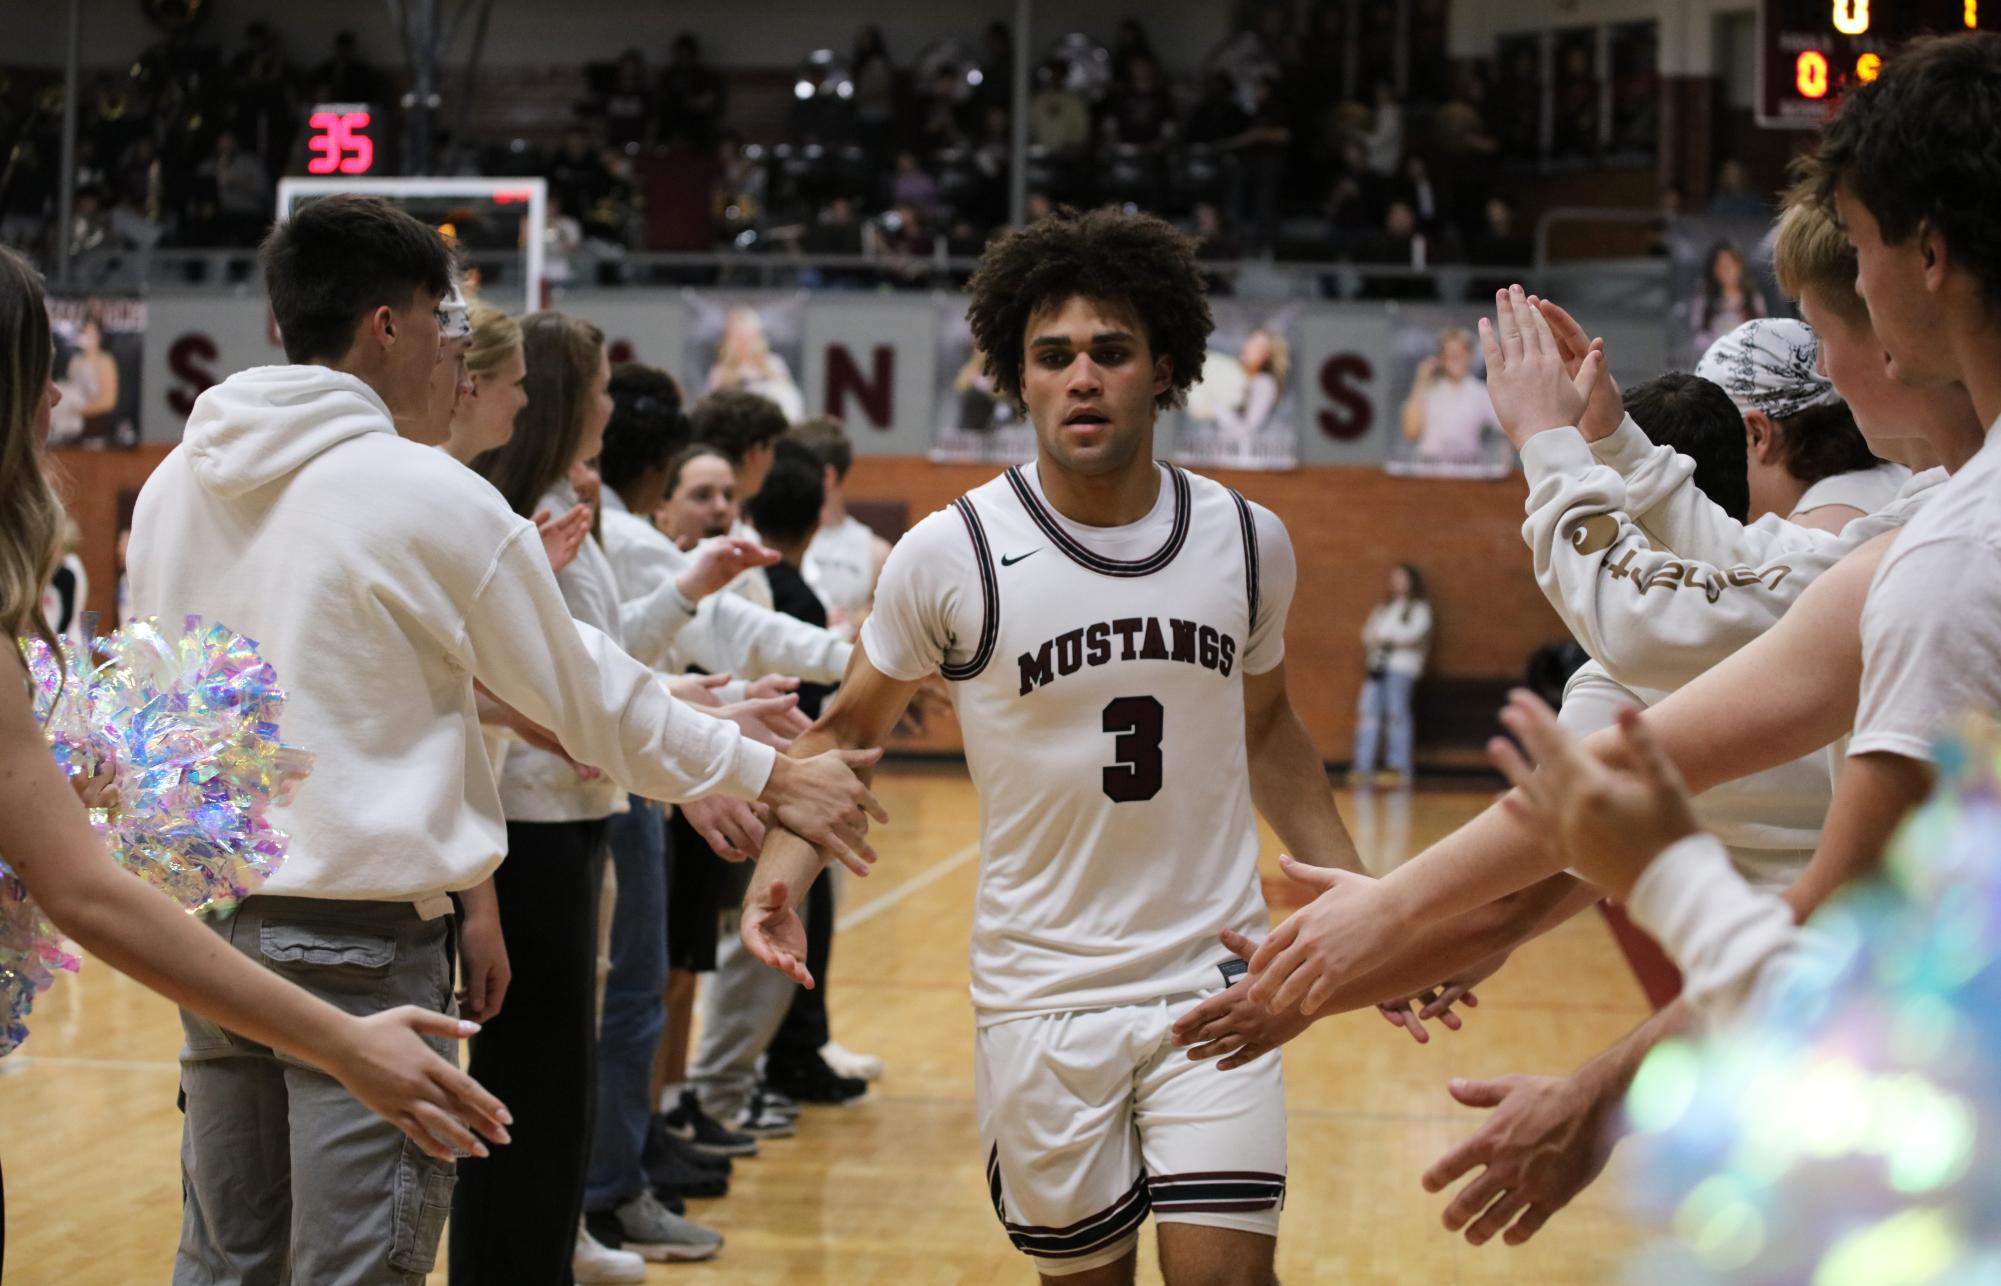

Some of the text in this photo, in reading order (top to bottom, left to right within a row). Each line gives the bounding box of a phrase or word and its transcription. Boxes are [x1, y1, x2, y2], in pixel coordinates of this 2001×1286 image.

[1797, 51, 1828, 98] 0
[308, 112, 374, 174] 35
[824, 343, 897, 431] N
[1316, 352, 1374, 440] S
[1018, 617, 1236, 696] MUSTANGS
[1103, 695, 1164, 803] 3
